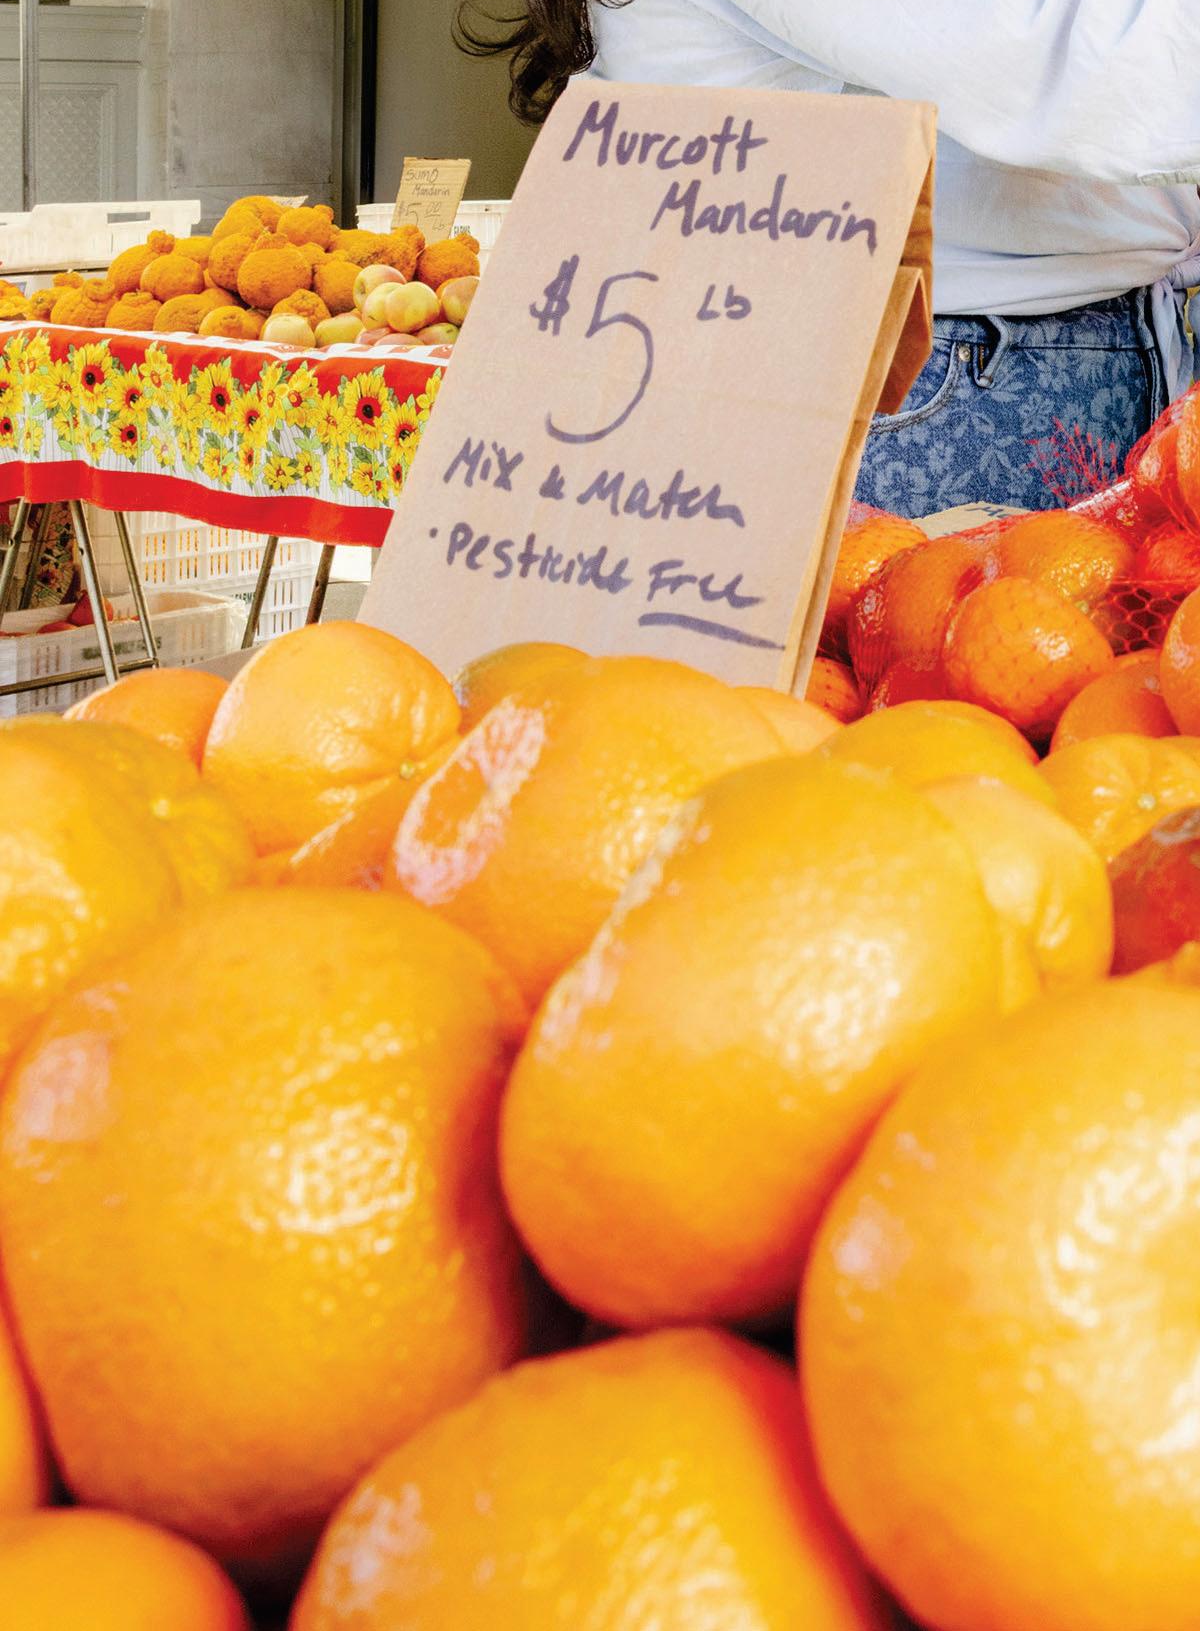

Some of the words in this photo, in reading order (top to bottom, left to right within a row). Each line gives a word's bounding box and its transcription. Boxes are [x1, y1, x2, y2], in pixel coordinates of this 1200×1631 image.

[563, 101, 768, 175] Murcott
[412, 184, 450, 197] Mandarin
[650, 174, 877, 256] Mandarin
[443, 437, 524, 491] Mix
[576, 469, 745, 528] Match
[646, 559, 766, 609] Free
